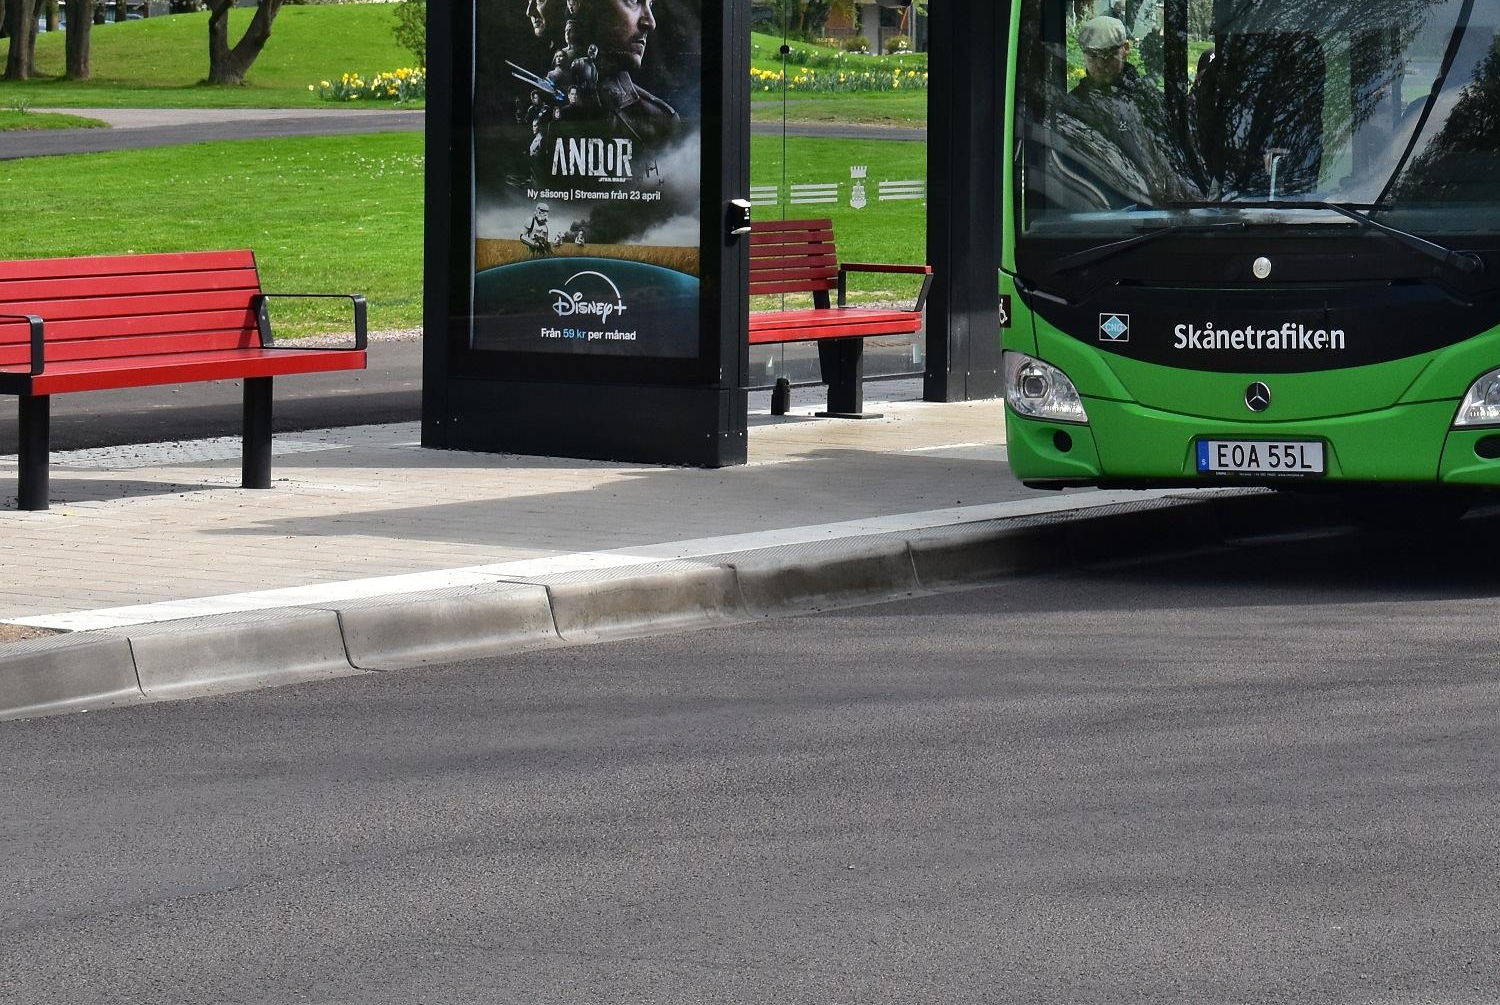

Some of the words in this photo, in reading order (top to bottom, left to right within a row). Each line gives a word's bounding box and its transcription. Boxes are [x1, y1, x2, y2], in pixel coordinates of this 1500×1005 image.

[551, 137, 633, 177] ANDOR
[527, 189, 539, 200] Ny
[540, 189, 569, 201] säsong
[575, 189, 609, 200] Streama
[610, 191, 628, 200] från
[629, 191, 641, 200] 23
[641, 191, 661, 202] april
[1105, 323, 1123, 332] CNG
[541, 328, 561, 338] Från
[563, 328, 575, 338] 59
[576, 329, 587, 338] kr
[588, 331, 603, 341] per
[605, 330, 637, 340] månad
[1174, 322, 1346, 351] Skånetrafiken
[1201, 458, 1207, 466] S
[1217, 444, 1260, 468] EOA
[1268, 445, 1312, 469] 55L
